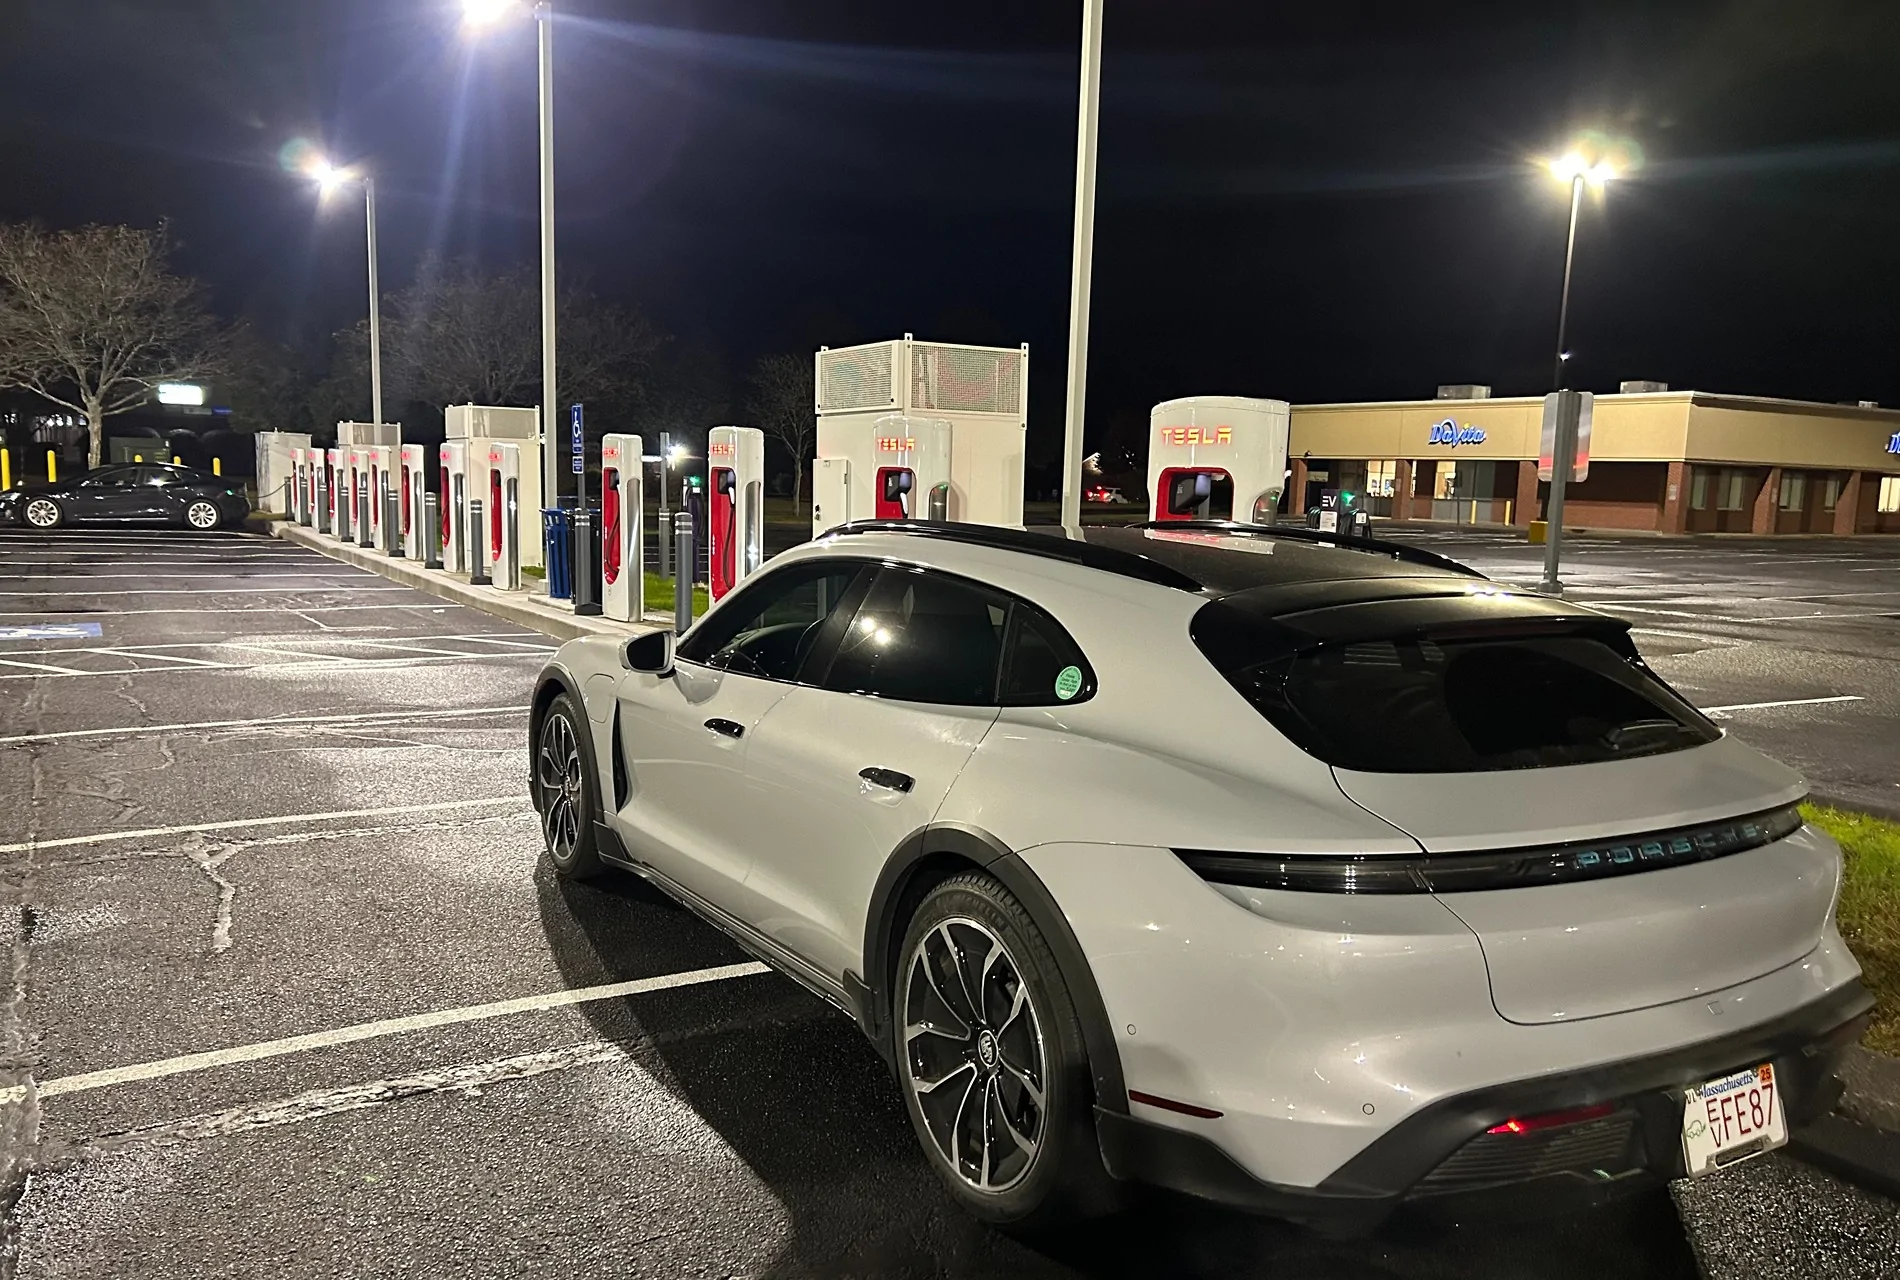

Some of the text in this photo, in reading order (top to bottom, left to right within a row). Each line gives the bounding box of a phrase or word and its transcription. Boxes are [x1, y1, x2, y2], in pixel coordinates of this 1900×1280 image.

[1162, 427, 1233, 445] TESLA
[1429, 419, 1486, 448] DaVita
[877, 437, 915, 451] TESLA
[1321, 495, 1337, 507] EV
[1574, 823, 1759, 871] PORSCHE
[1761, 1067, 1771, 1080] 25
[1700, 1074, 1754, 1099] Massachusetts
